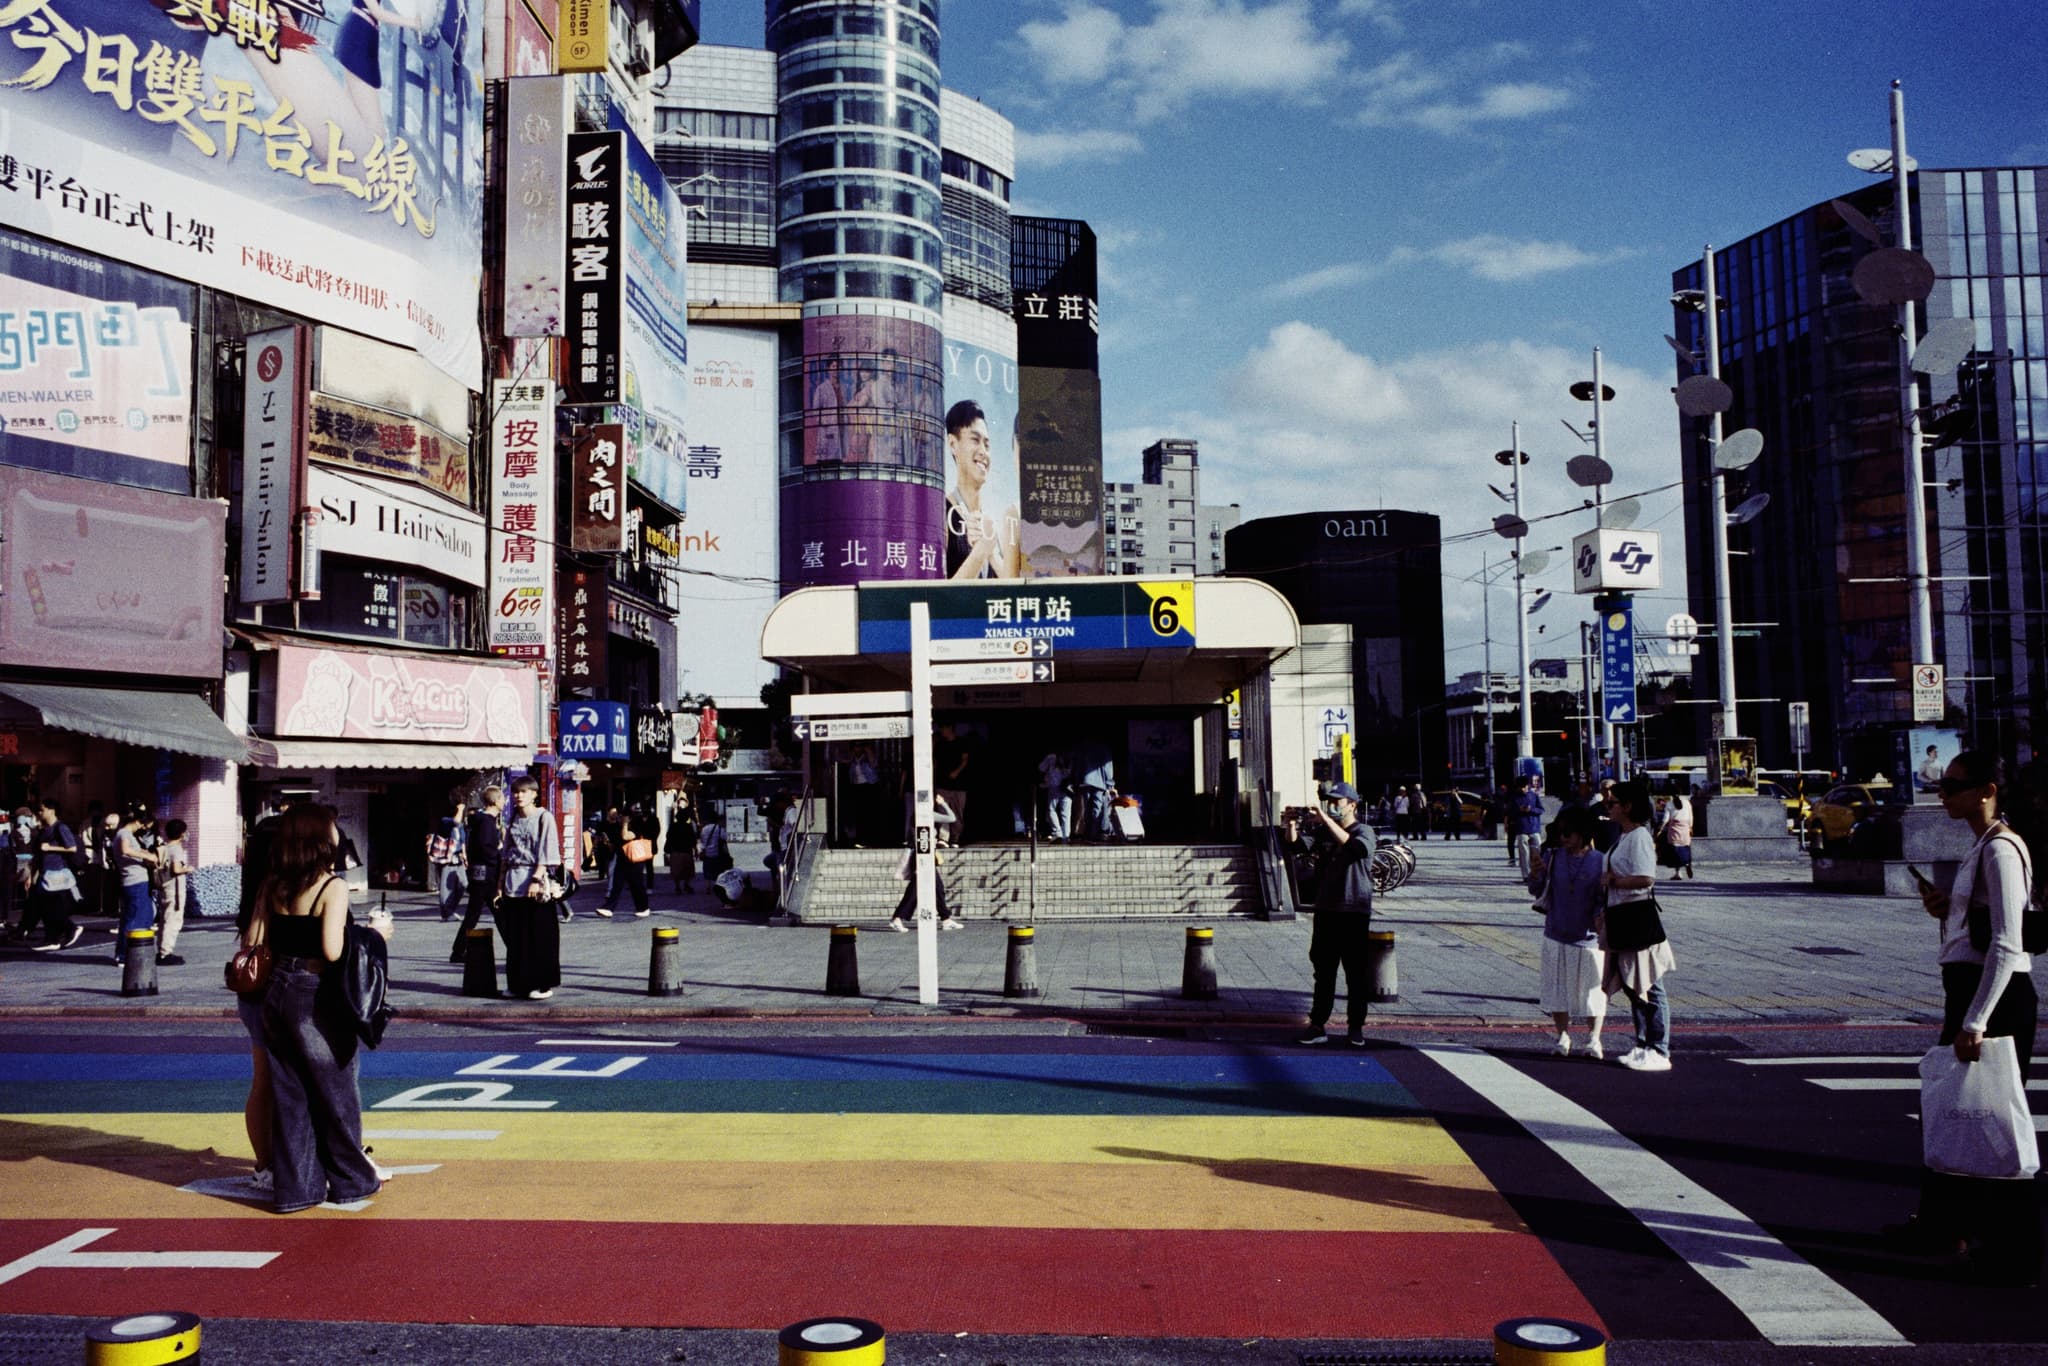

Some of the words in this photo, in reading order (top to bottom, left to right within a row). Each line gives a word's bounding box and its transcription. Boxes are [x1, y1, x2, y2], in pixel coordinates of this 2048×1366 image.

[574, 46, 586, 56] 5F
[0, 0, 437, 238] 今日雙平台上線
[570, 181, 608, 190] AORUS
[572, 202, 609, 282] 駭客
[1024, 293, 1084, 321] 立莊
[605, 354, 615, 385] 西門店
[945, 345, 1017, 393] YOU
[603, 388, 616, 398] 4F
[503, 420, 538, 478] 按摩
[687, 445, 722, 479] 壽
[259, 441, 275, 505] Hair
[510, 482, 530, 493] Body
[588, 439, 616, 521] 肉之間
[377, 505, 432, 542] Hair
[434, 520, 473, 559] Salon
[502, 504, 537, 563] 護膚
[948, 505, 1018, 546] GOT
[256, 508, 272, 584] Salon
[801, 540, 937, 571] 臺北馬拉
[509, 567, 530, 575] Face
[986, 597, 1073, 624] 西門站
[1152, 596, 1179, 635] 6
[985, 628, 1022, 639] XIMEN
[1025, 627, 1075, 638] STATION
